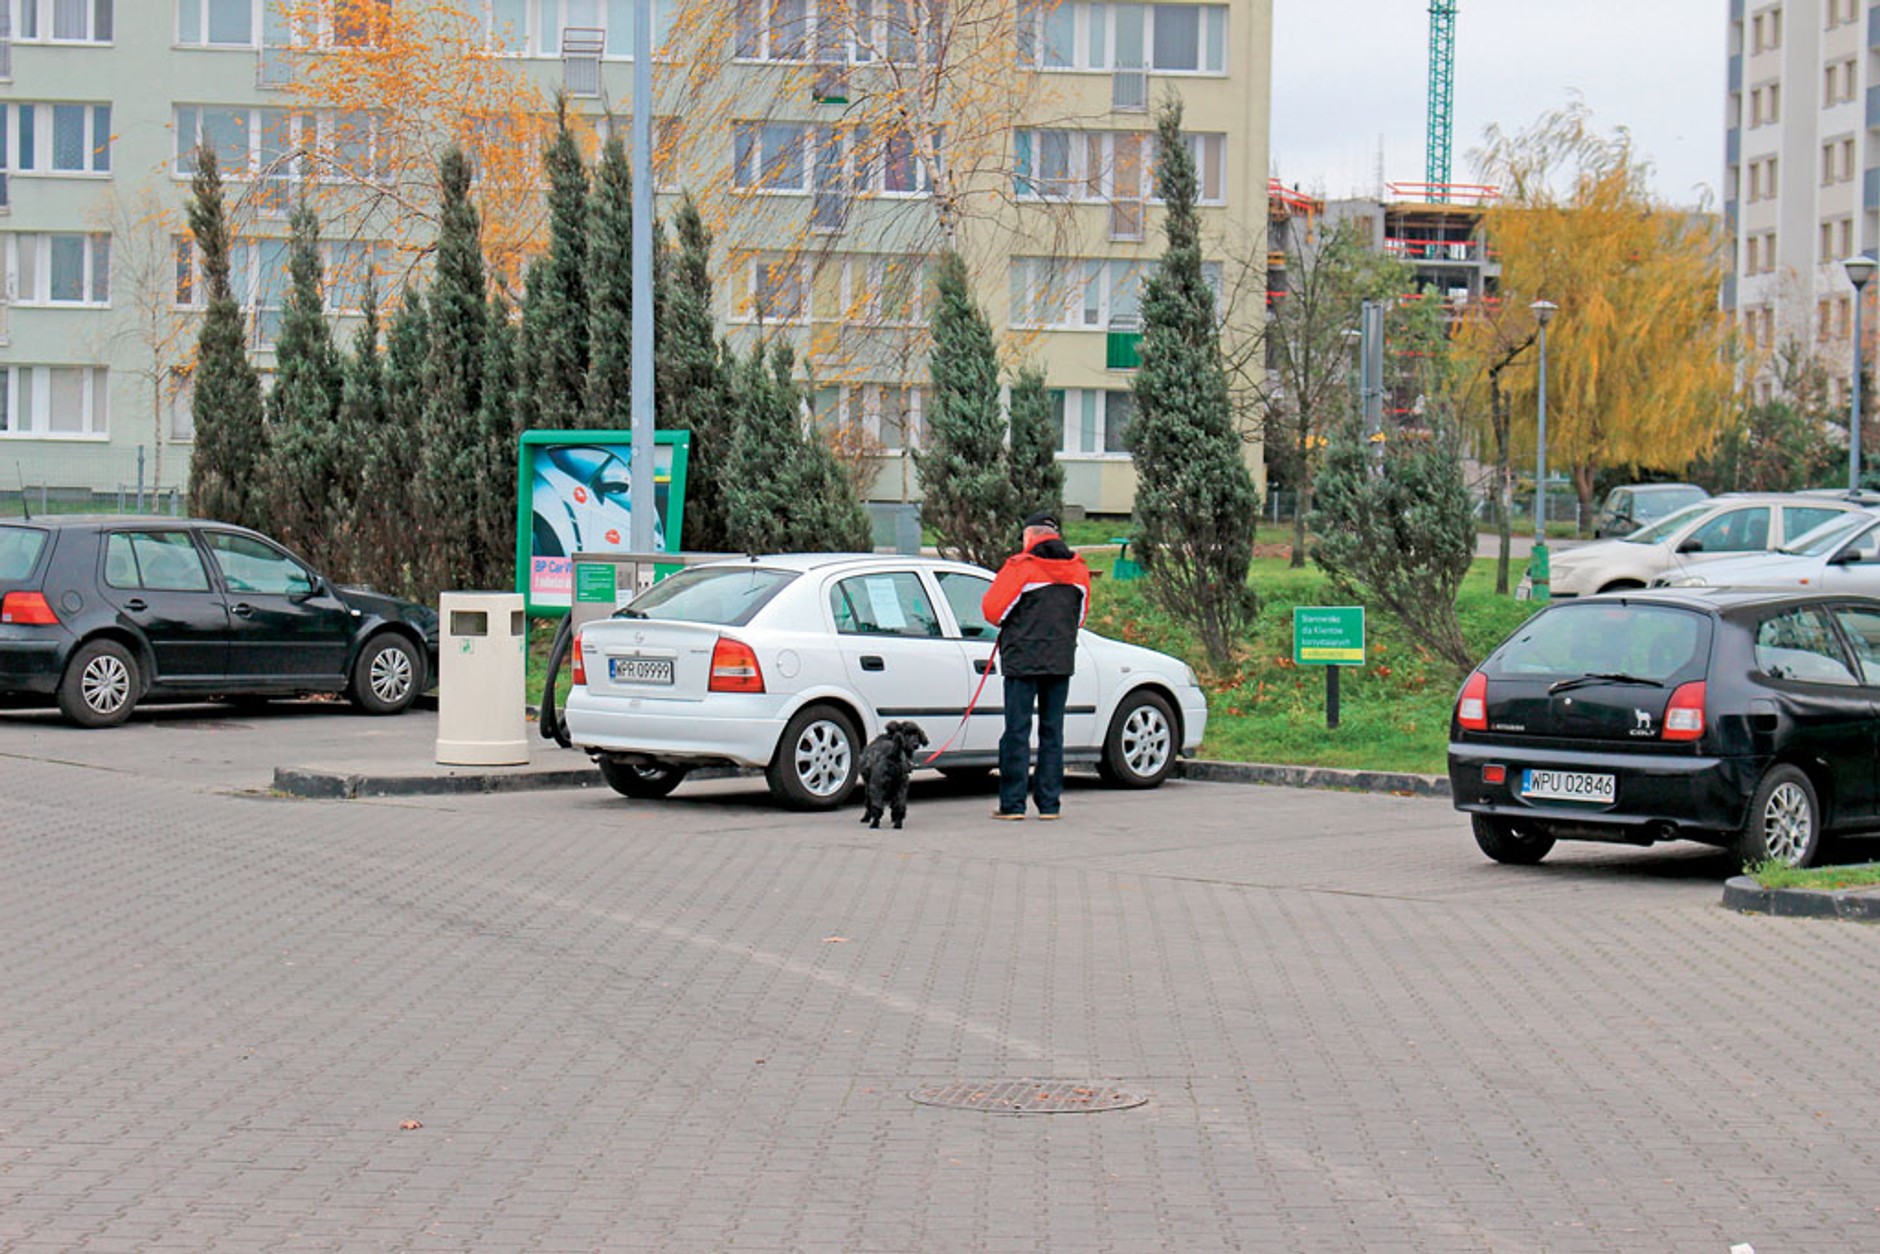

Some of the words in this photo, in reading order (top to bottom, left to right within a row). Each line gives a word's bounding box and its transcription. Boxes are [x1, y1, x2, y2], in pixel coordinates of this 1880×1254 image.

[535, 560, 547, 572] BP
[616, 661, 636, 676] WPR
[638, 662, 670, 678] 09999
[1532, 771, 1561, 792] WPU
[1565, 775, 1613, 795] 02846
